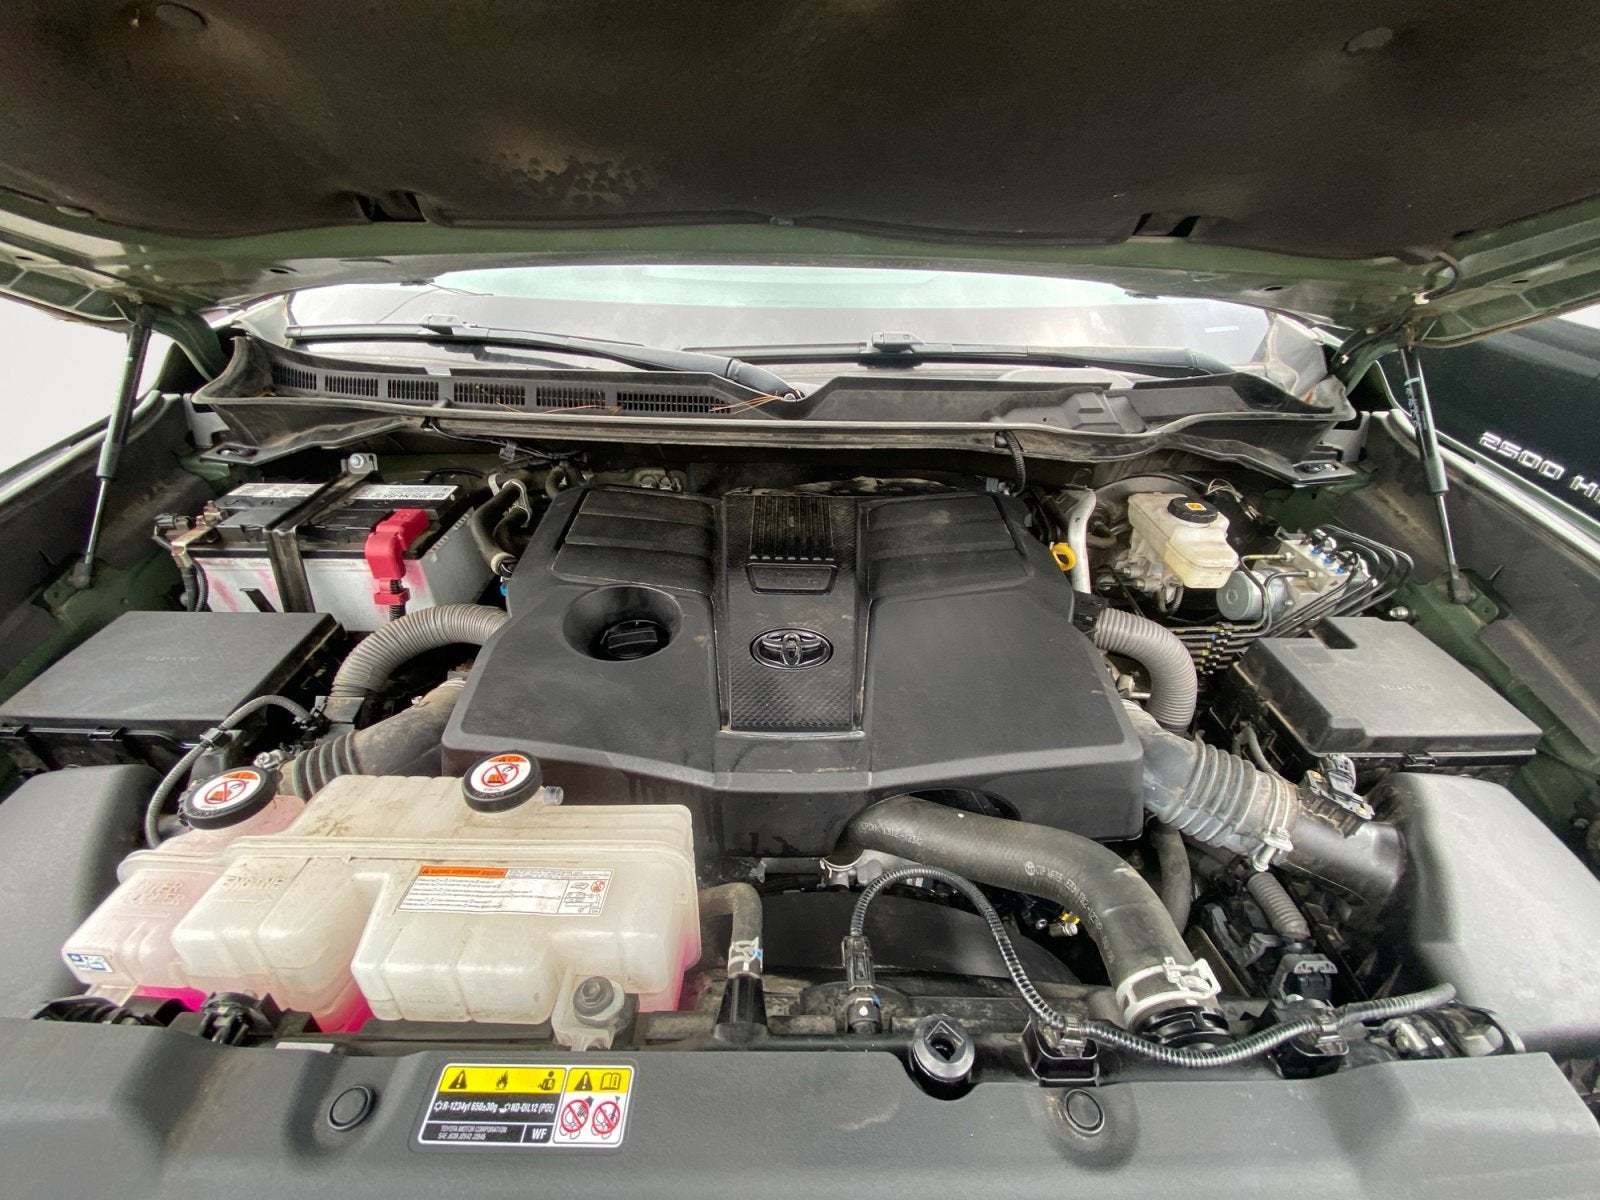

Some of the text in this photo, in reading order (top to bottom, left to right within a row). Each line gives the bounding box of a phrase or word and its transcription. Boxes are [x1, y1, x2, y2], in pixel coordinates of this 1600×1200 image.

[1479, 431, 1600, 505] 2500 H
[538, 1103, 555, 1115] (POE)
[532, 1128, 548, 1140] WF
